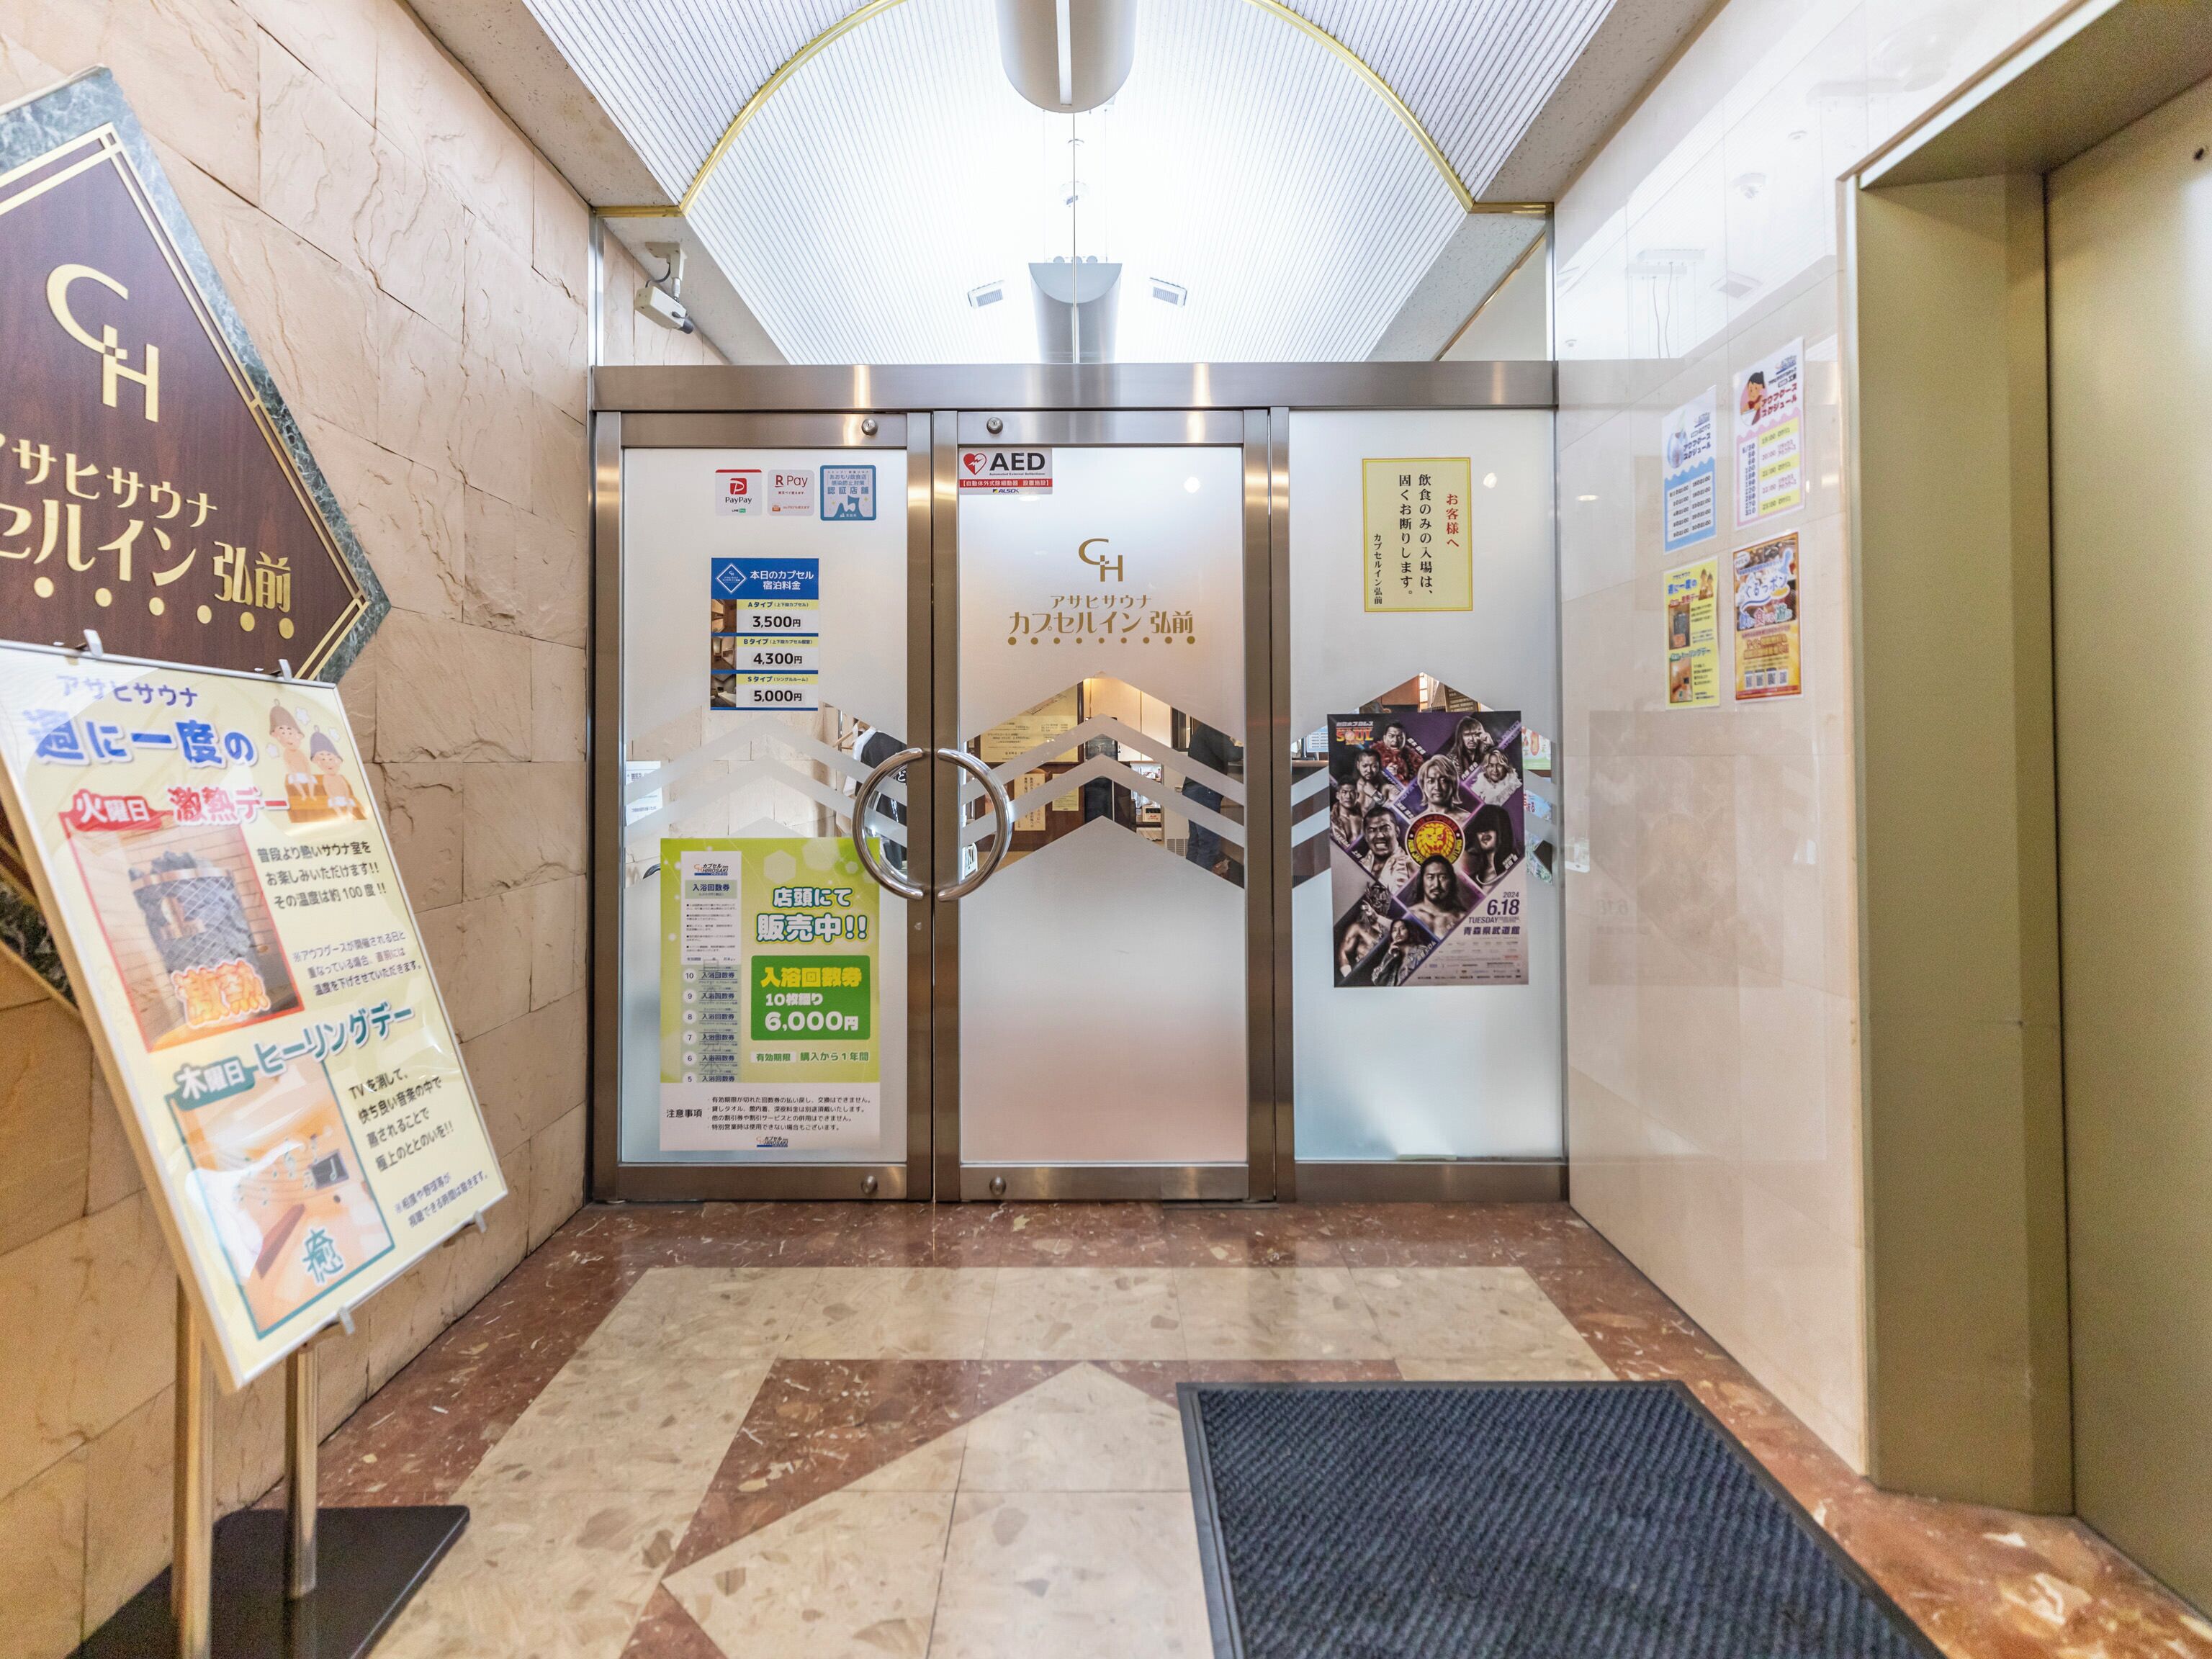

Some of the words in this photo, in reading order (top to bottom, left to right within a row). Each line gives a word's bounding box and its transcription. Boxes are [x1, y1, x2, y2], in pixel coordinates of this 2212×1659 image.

[989, 453, 1046, 471] AED
[0, 433, 218, 528] サヒサウナ
[787, 475, 808, 487] Pay
[1446, 493, 1459, 547] お客様へ
[1399, 475, 1413, 595] 固くお断りします。
[1419, 474, 1433, 594] 飲食のみの入場は、
[750, 570, 814, 580] 本日のカプセル
[1374, 534, 1382, 604] カプセルイン弘前
[763, 581, 801, 590] 宿泊料金
[1050, 594, 1152, 609] アサヒサウナ
[752, 616, 801, 629] 3,500円
[753, 652, 802, 665] 4,300円
[56, 675, 198, 707] アサヒサウナ
[754, 690, 802, 702] 5,000円
[23, 709, 256, 766] 週に一度の
[76, 793, 151, 824] 火曜日
[167, 786, 289, 826] 激熱デー
[257, 841, 372, 863] 普段より熱いサウナ室を
[773, 887, 853, 907] 店頭にて
[1487, 899, 1520, 915] 6.18
[757, 913, 868, 942] 販売中!!
[1464, 926, 1520, 935] 青森県武道館
[760, 967, 862, 988] 入浴回数券
[765, 1011, 859, 1031] 6,000円
[176, 1062, 246, 1099] 木曜日
[255, 1002, 415, 1076] ヒーリングデー
[757, 1053, 791, 1061] 有効期限
[666, 1109, 703, 1118] 注意事項
